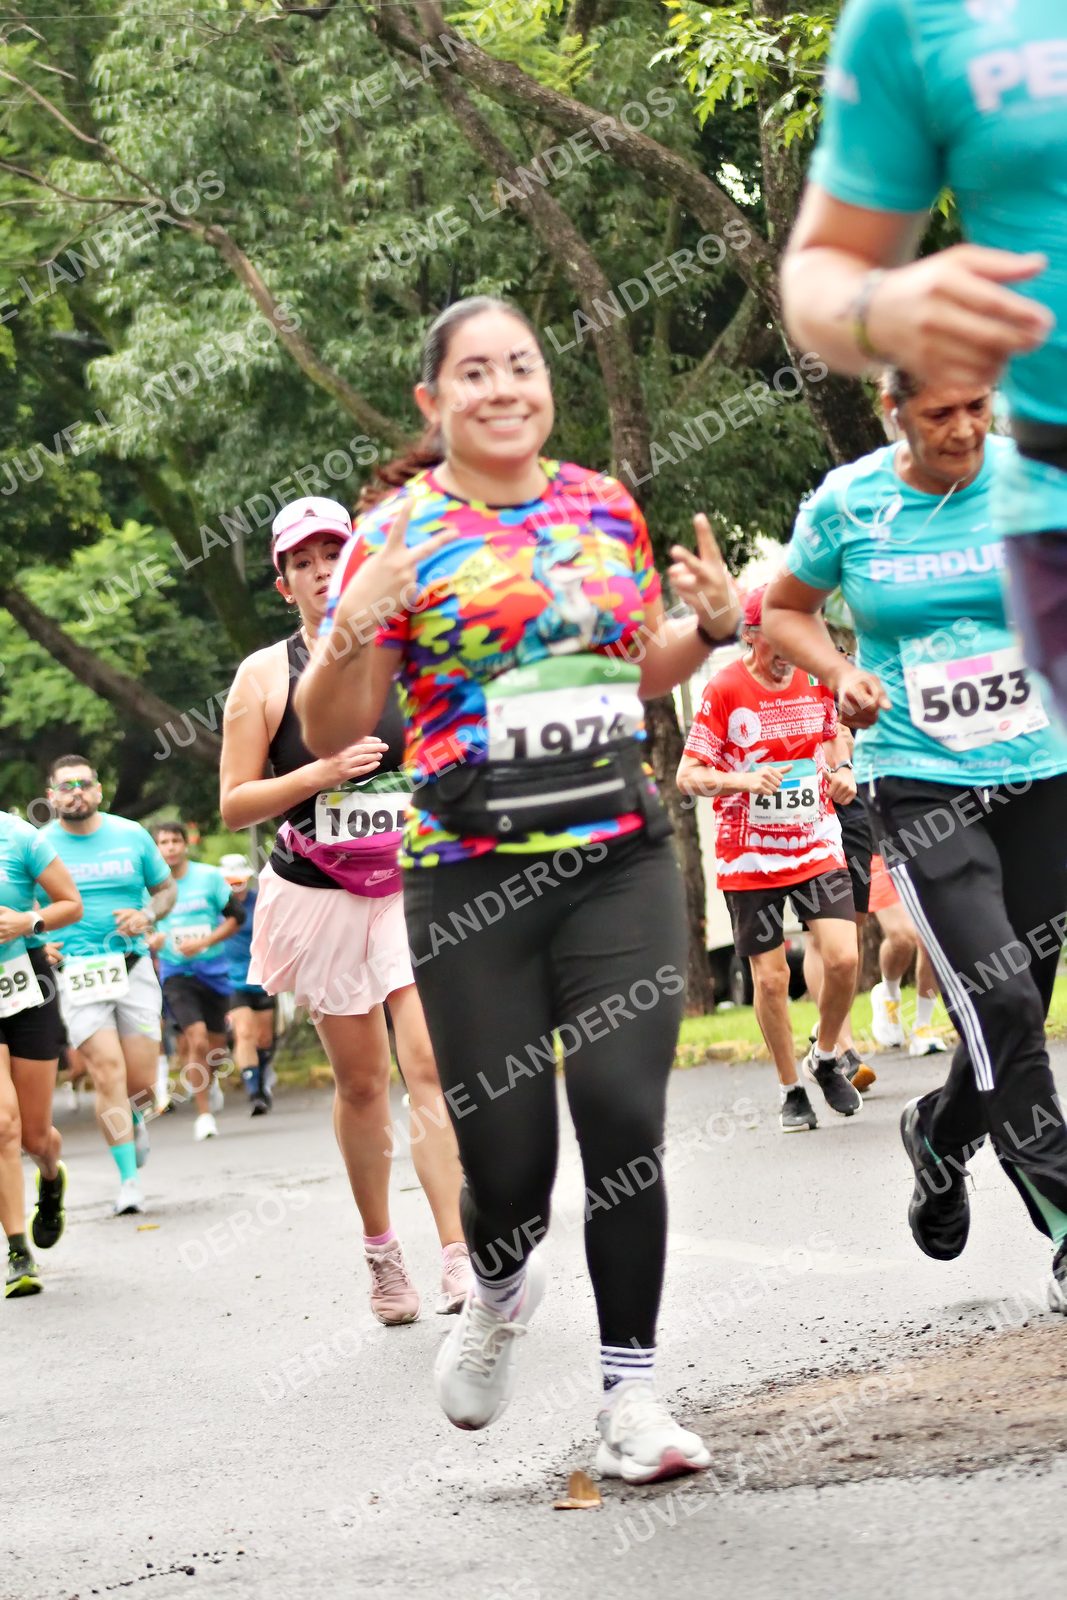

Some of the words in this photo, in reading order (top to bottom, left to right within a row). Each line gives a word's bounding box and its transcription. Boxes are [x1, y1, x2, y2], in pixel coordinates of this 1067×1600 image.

[921, 668, 1031, 723] 5033
[755, 788, 815, 810] 4138
[371, 869, 395, 879] NIKE
[69, 967, 122, 991] 3512
